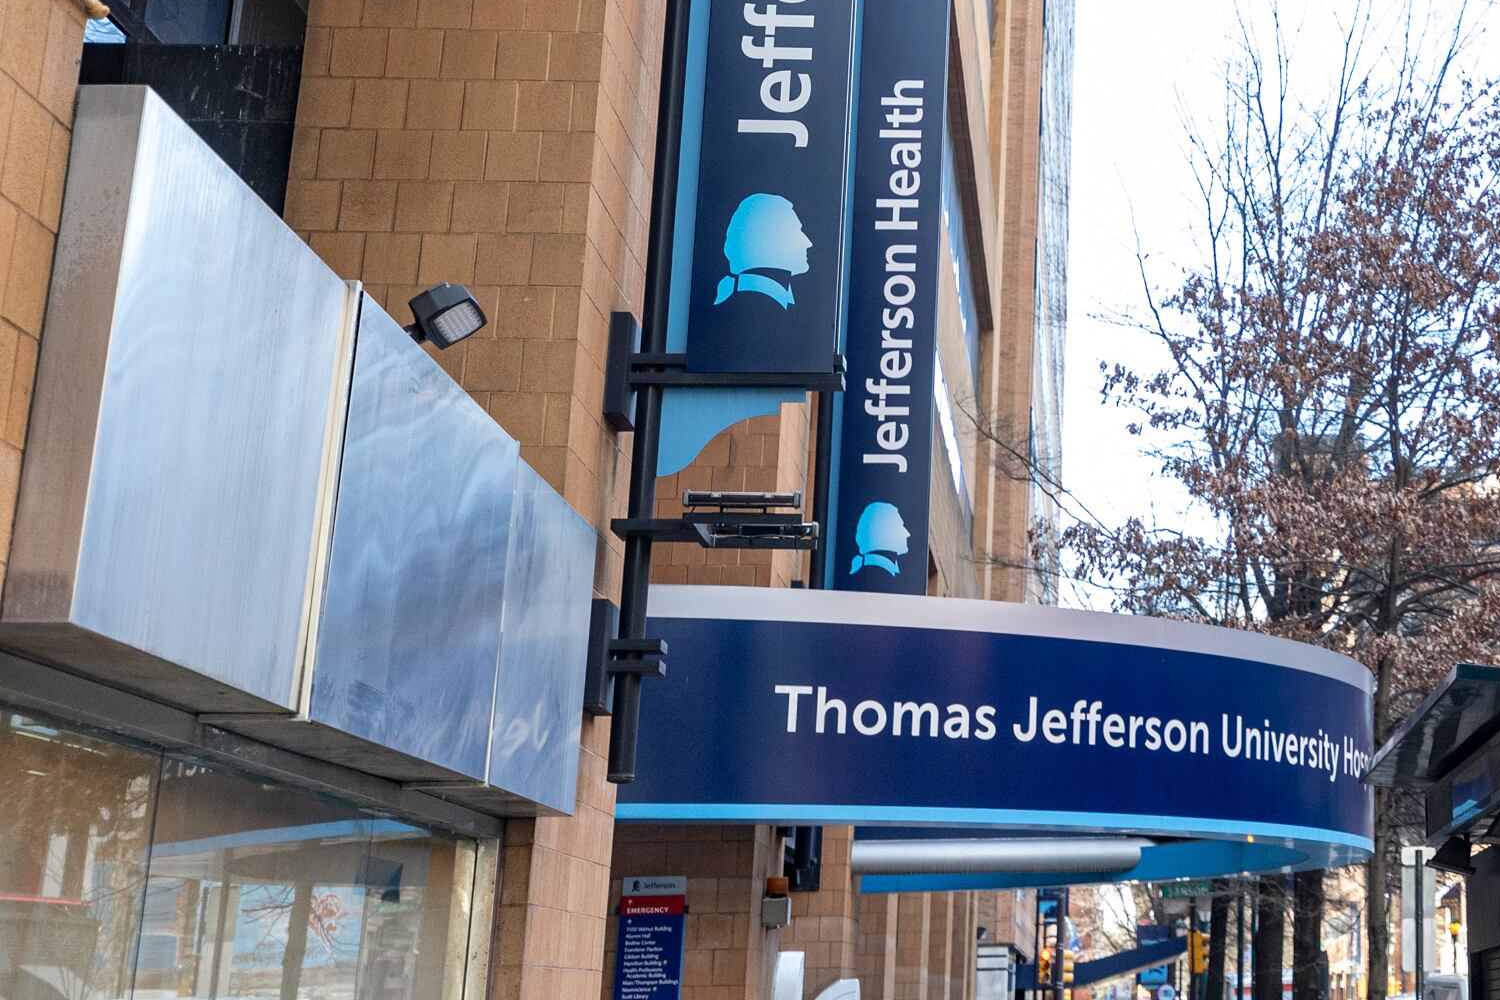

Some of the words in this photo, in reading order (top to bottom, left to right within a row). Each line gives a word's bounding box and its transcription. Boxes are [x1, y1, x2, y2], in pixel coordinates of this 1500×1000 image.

[875, 79, 925, 231] Health
[862, 243, 917, 473] Jefferson
[774, 684, 997, 741] Thomas
[1012, 696, 1210, 755] Jefferson
[1222, 713, 1340, 783] University
[626, 906, 669, 914] EMERGENCY
